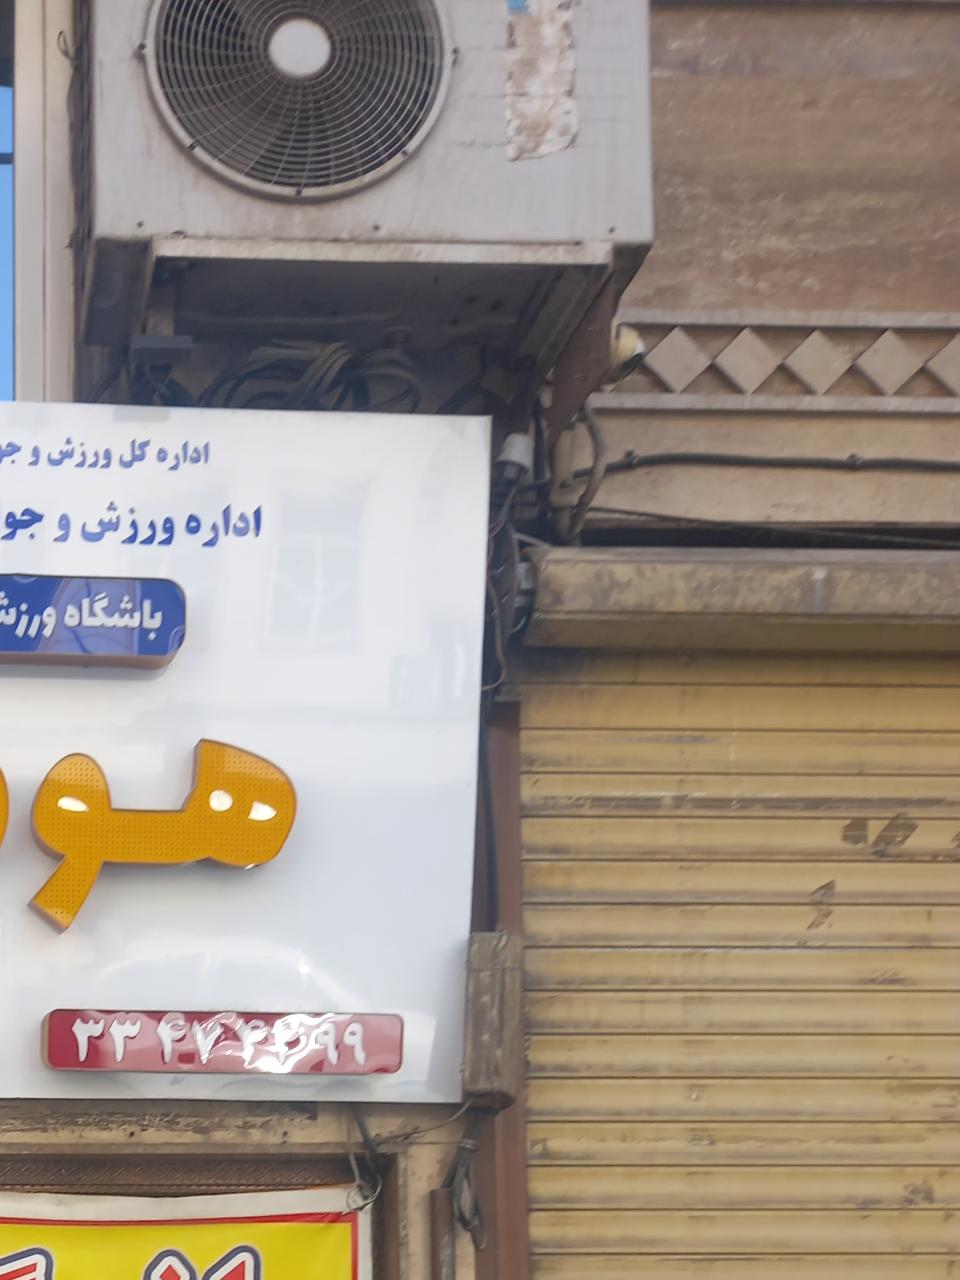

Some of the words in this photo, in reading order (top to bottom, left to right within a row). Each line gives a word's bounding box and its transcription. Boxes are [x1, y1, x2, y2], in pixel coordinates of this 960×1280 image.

[28, 445, 40, 466] و
[47, 437, 112, 468] ورزش
[119, 438, 151, 468] کل
[156, 440, 210, 471] اداره
[52, 513, 71, 542] و
[80, 500, 175, 546] ورزش
[185, 504, 262, 547] اداره
[62, 592, 163, 640] باشگاه
[72, 1017, 142, 1064] ۳۳
[156, 1012, 222, 1064] ۴۷
[315, 1022, 367, 1066] ۹۹
